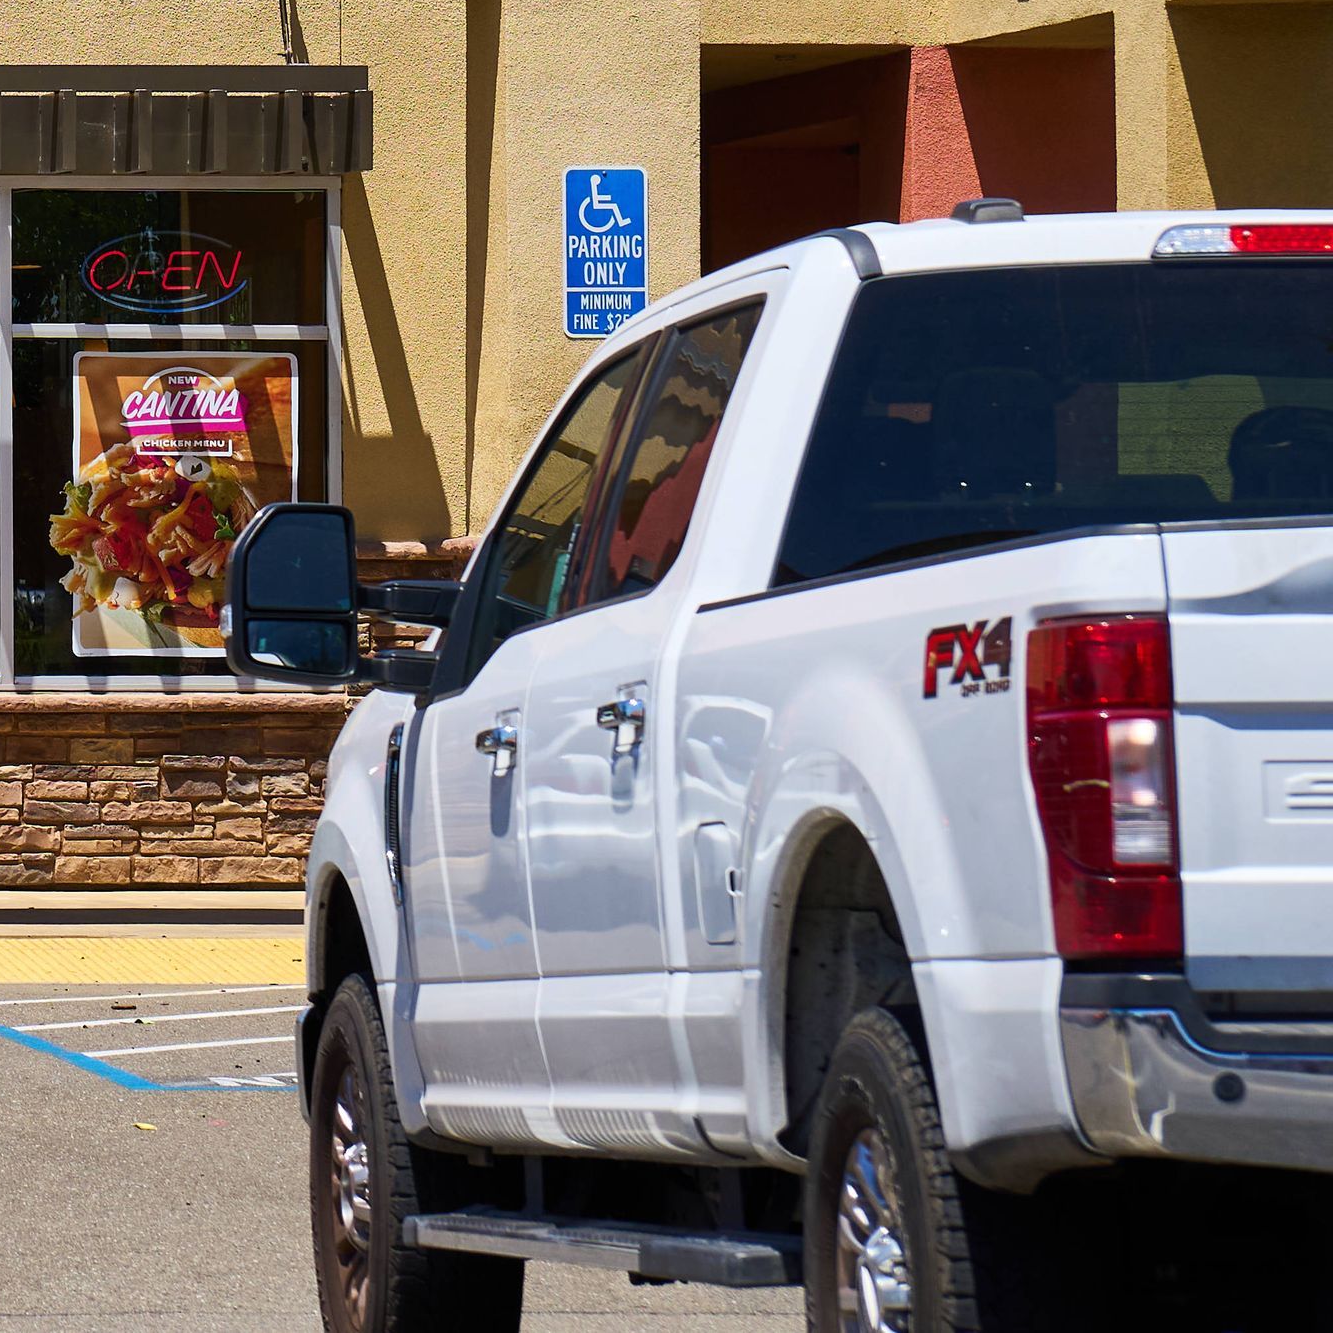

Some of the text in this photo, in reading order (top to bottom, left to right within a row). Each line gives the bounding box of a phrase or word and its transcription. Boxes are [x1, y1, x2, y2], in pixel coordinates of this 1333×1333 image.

[568, 235, 642, 258] PARKING
[90, 250, 242, 290] OPEN
[583, 261, 627, 285] ONLY
[580, 294, 631, 309] MINIMUM
[574, 312, 630, 331] FINE $2
[168, 376, 197, 384] NEW
[121, 388, 240, 419] CANTINA
[143, 439, 225, 447] CHICKEN MENU
[923, 616, 1013, 699] FX4
